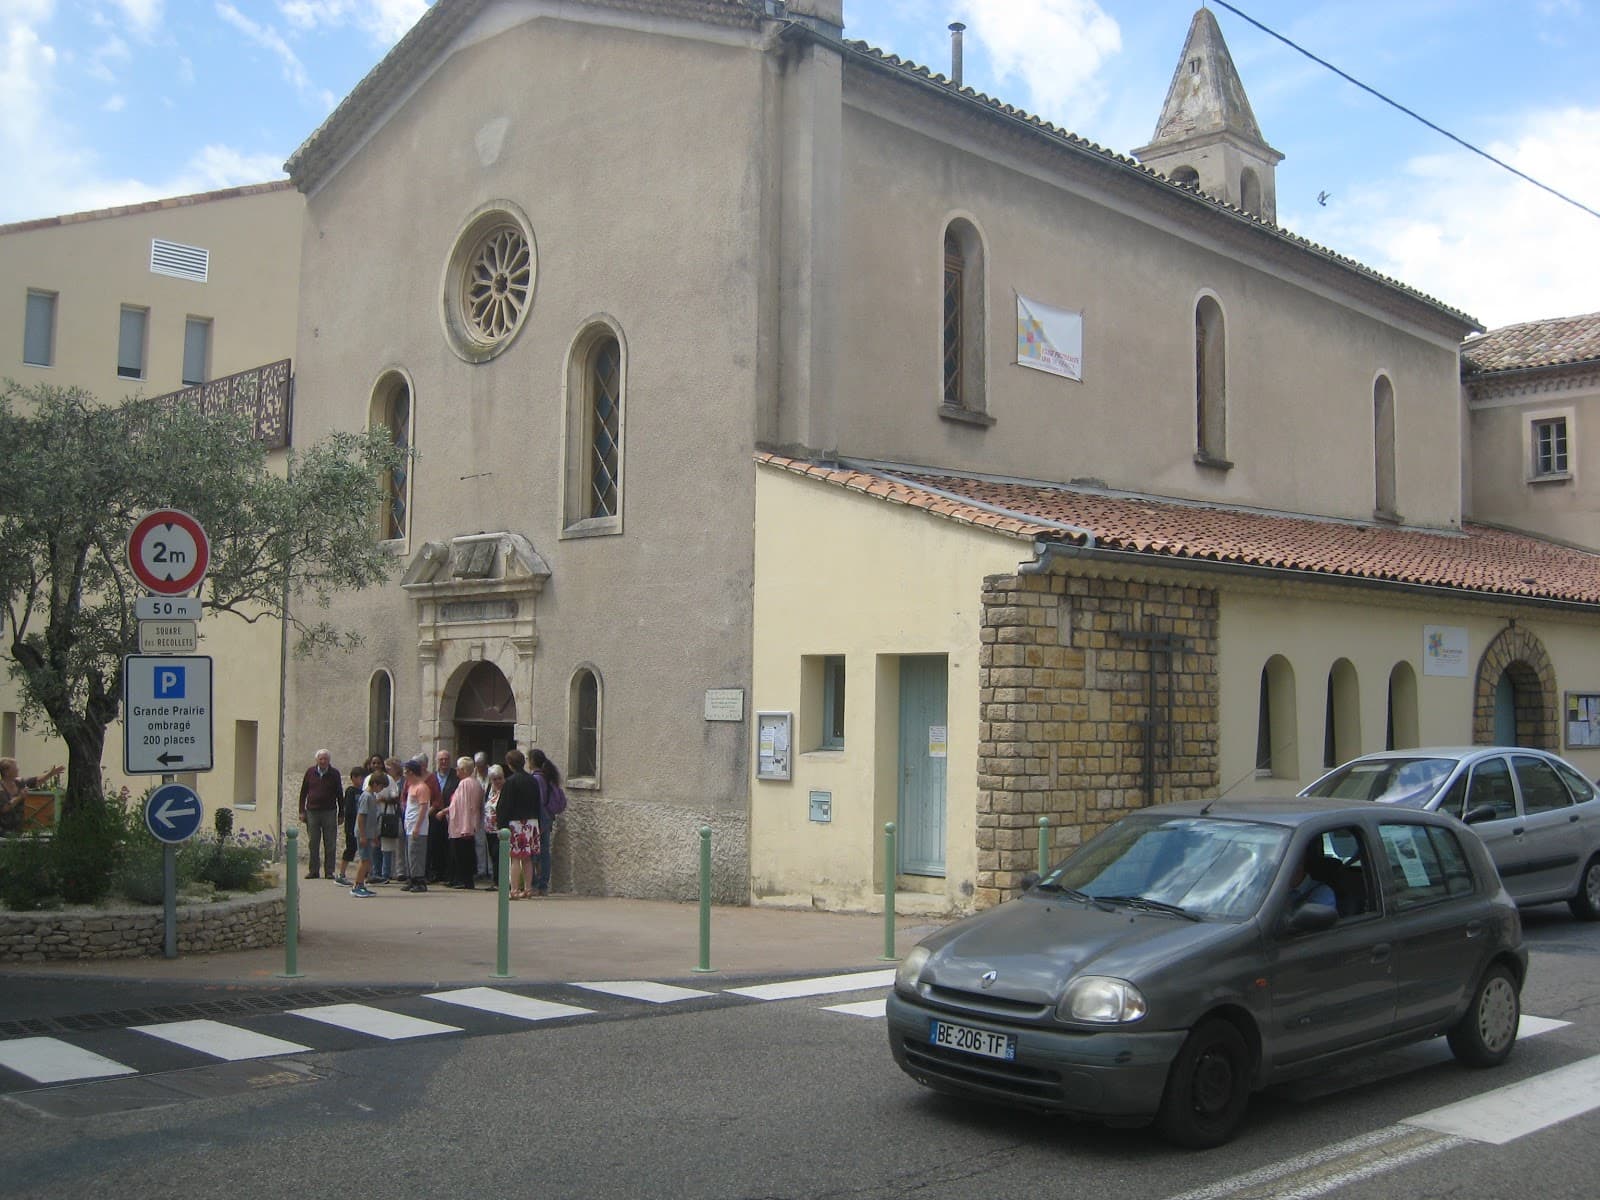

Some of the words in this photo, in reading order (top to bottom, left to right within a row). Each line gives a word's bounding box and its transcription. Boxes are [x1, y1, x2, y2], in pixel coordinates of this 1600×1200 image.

[153, 602, 173, 615] 50
[177, 607, 187, 615] m
[156, 626, 182, 636] SQUARE
[161, 671, 177, 694] P
[133, 706, 169, 716] Grande
[172, 705, 205, 716] Prairie
[147, 720, 191, 732] ombragé
[143, 735, 161, 745] 200
[163, 735, 196, 747] places
